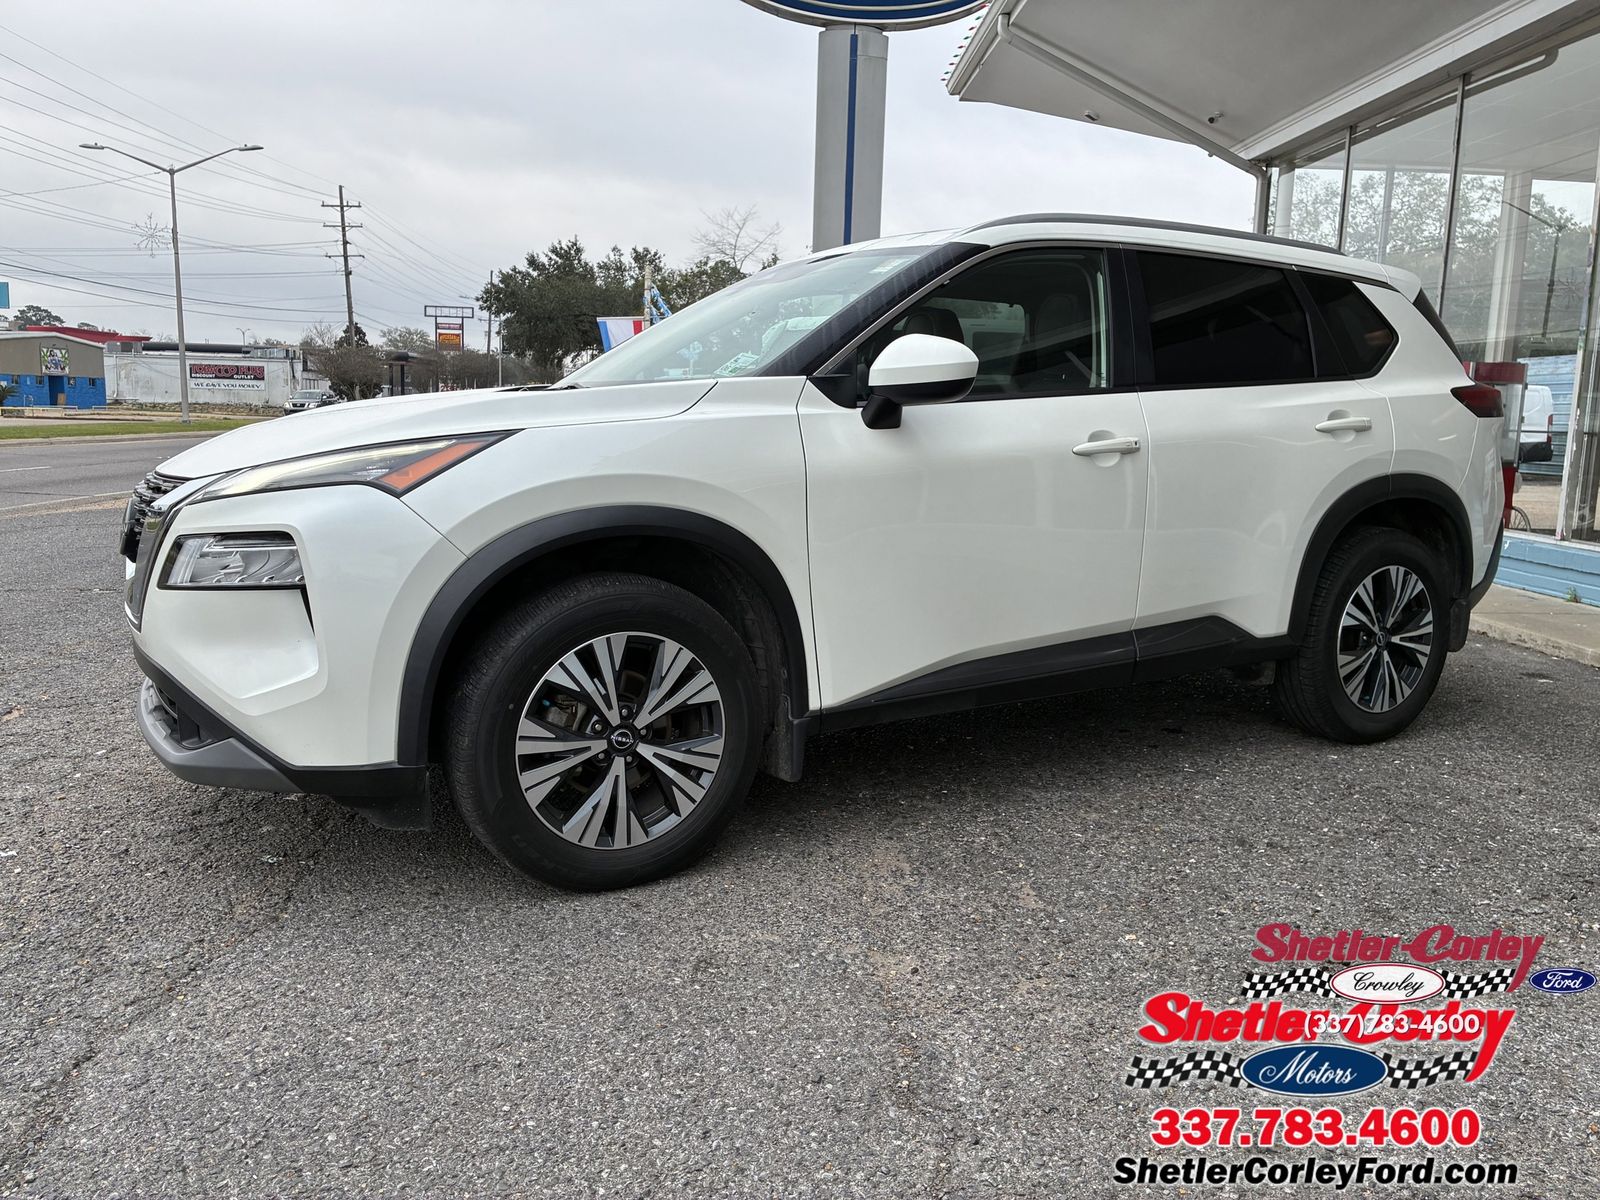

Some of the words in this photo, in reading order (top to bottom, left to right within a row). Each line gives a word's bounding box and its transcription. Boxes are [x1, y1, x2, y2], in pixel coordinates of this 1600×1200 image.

[191, 364, 237, 377] TOBACCO
[239, 366, 264, 378] PLUS
[611, 735, 634, 743] NISSAN
